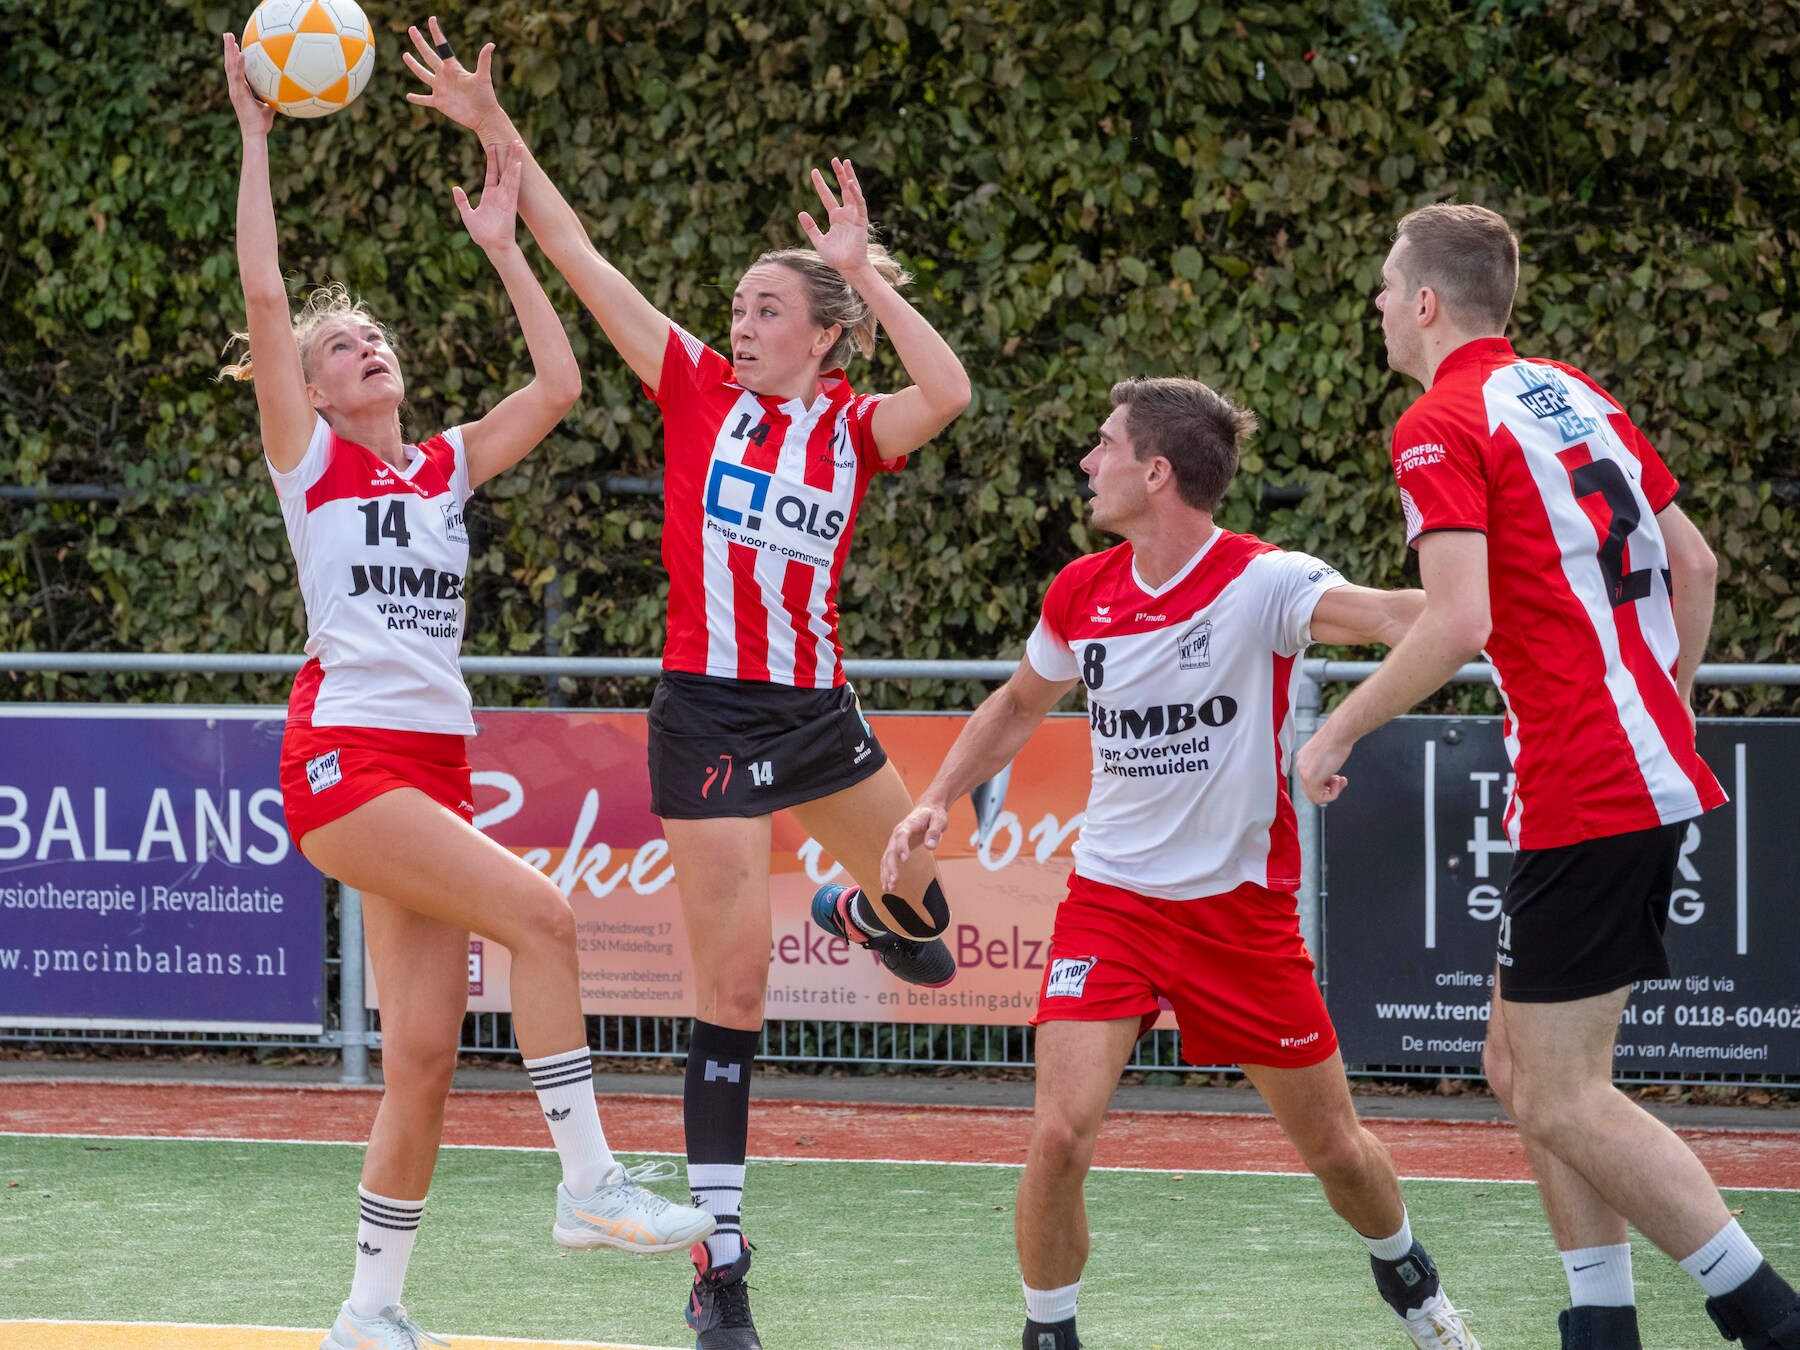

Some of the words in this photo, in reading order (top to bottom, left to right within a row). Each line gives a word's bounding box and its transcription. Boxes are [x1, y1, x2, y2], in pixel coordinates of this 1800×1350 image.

[730, 412, 771, 448] 14
[1401, 443, 1446, 461] KORFBAL
[1403, 453, 1441, 472] TOTAAL
[371, 478, 394, 486] erima
[358, 500, 411, 547] 14
[775, 495, 844, 540] QLS
[740, 534, 767, 548] voor
[769, 542, 830, 568] e-commerce
[1193, 634, 1206, 652] TOP
[1083, 643, 1106, 690] 8
[1090, 695, 1238, 740] JUMBO
[853, 748, 872, 765] erima
[1124, 736, 1210, 760] Overveld
[748, 761, 774, 786] 14
[0, 786, 289, 865] BALANS
[152, 885, 283, 913] Revalidatie
[658, 922, 672, 935] 17
[590, 940, 607, 952] SN
[608, 940, 673, 956] Middelburg
[956, 924, 1053, 970] Belz
[1065, 964, 1086, 979] TOP
[1435, 970, 1483, 986] online
[1685, 976, 1709, 995] tijd
[1713, 976, 1735, 992] via
[877, 991, 899, 1005] en
[1642, 1004, 1666, 1025] of
[1402, 1035, 1424, 1051] De
[1638, 1044, 1665, 1058] van
[1668, 1042, 1768, 1060] Arnemuiden!
